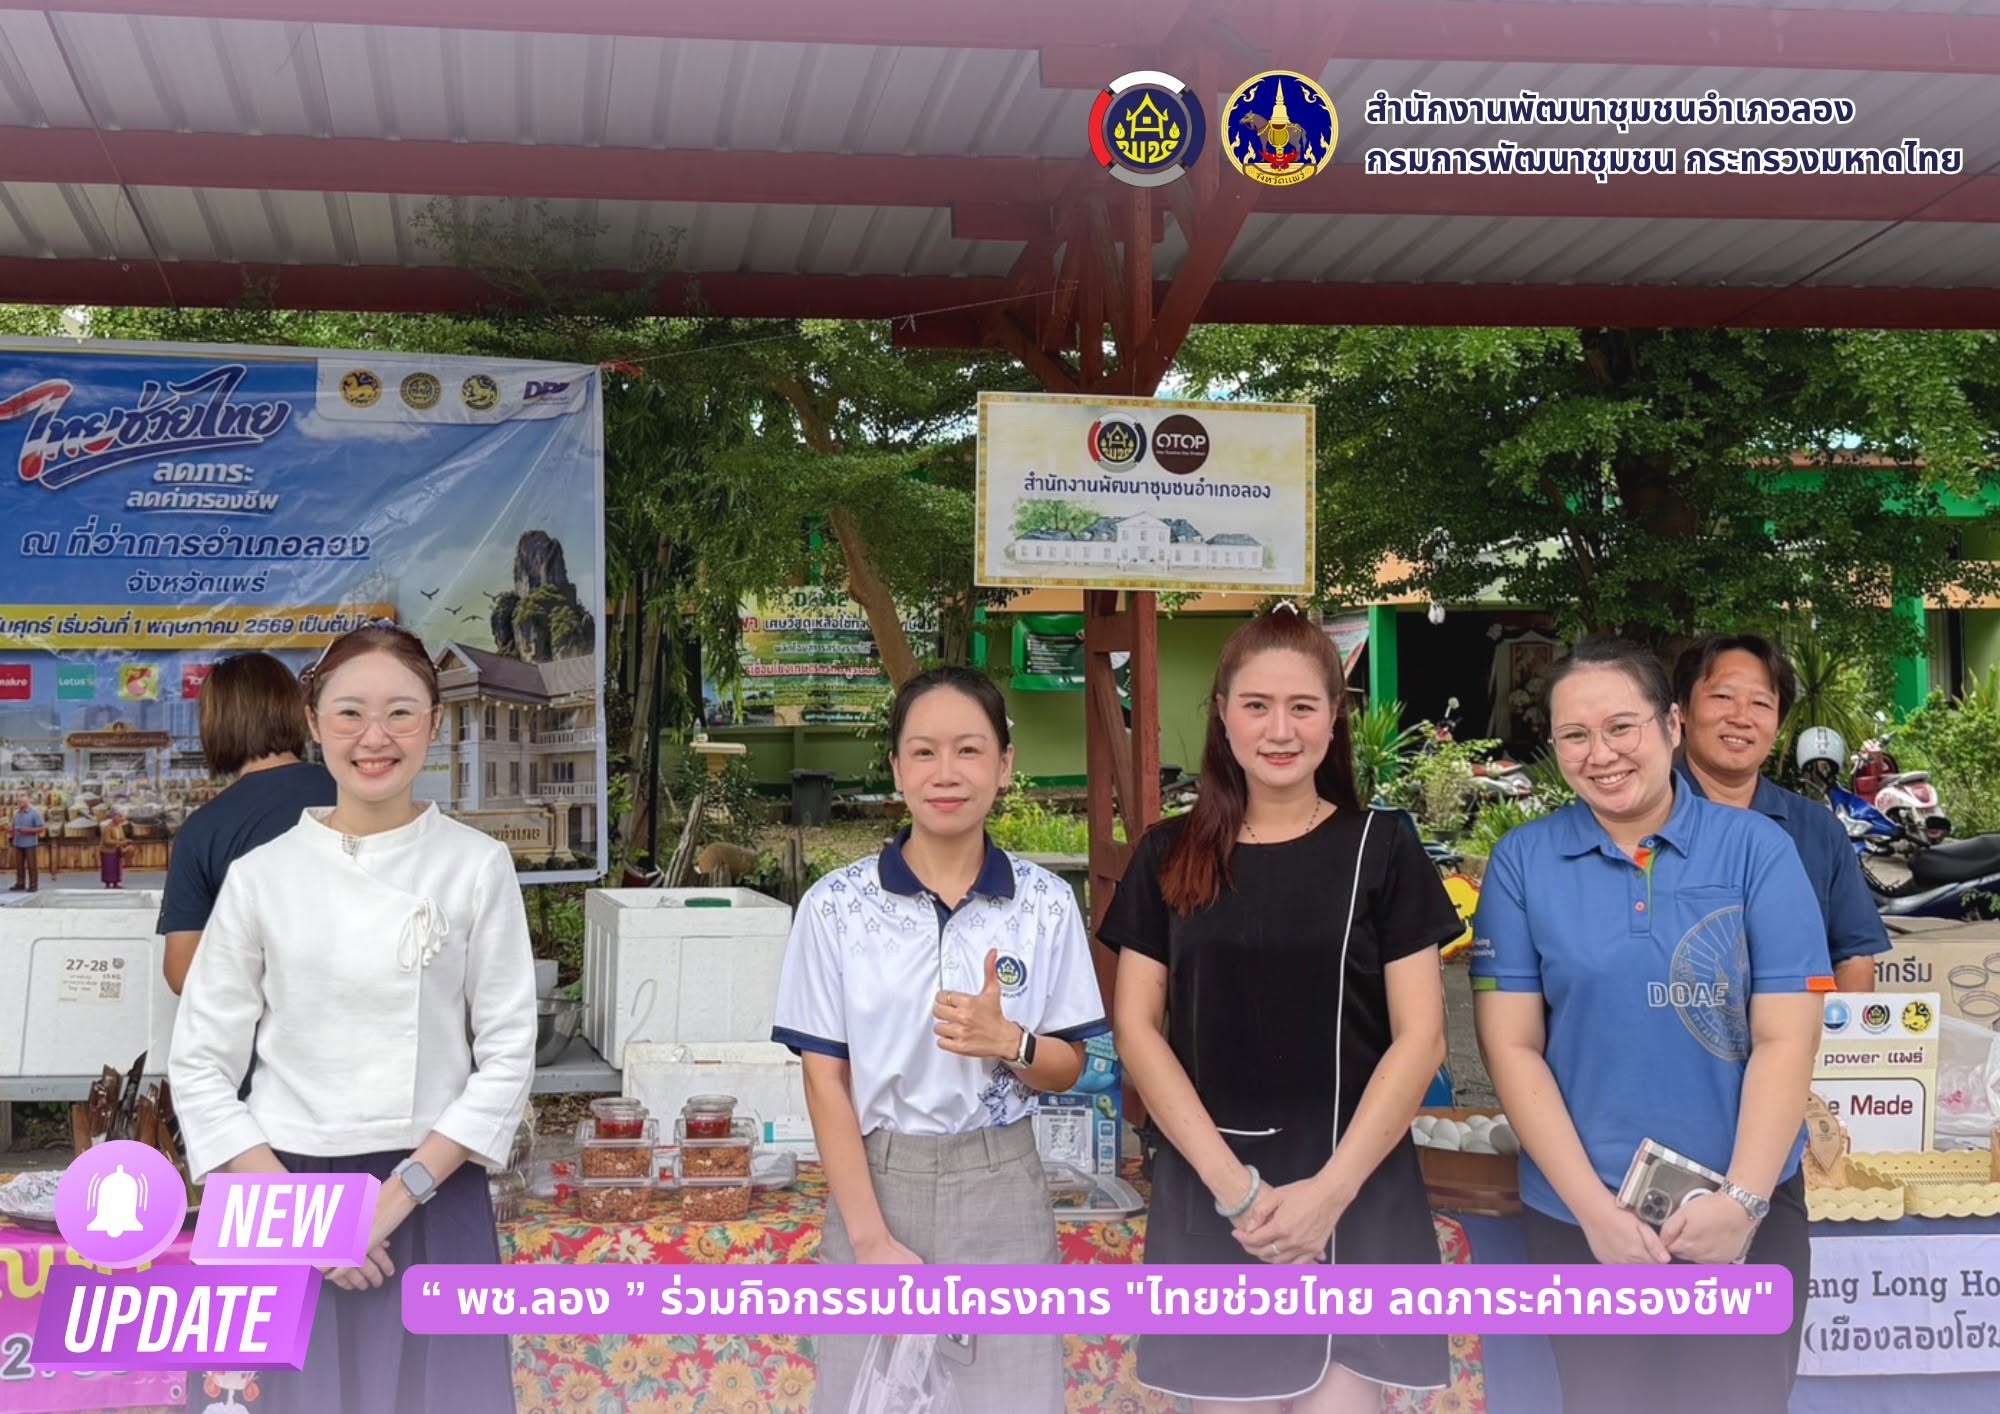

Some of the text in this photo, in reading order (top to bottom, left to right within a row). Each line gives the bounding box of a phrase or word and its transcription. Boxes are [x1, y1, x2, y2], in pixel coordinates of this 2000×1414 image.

[1156, 433, 1207, 448] OTOP
[153, 462, 254, 483] ลดภาระ
[1024, 471, 1271, 501] สำนักงานพัฒนาชุมชนอำเภอลอง
[126, 487, 279, 511] ลดค่าครองชีพ
[22, 517, 370, 558] ณ ที่ว่าการอำเภอลอง
[127, 570, 267, 594] จังหวัดแพร่
[57, 611, 131, 634] เริ่มวันที่
[133, 619, 141, 634] 1
[147, 618, 239, 636] พฤษภาคม
[244, 618, 294, 633] 2569
[65, 958, 109, 972] 27-28
[1647, 981, 1729, 1008] DOAE
[1824, 1046, 1923, 1067] power แพร่
[1850, 1095, 1913, 1116] Made
[1872, 1271, 1948, 1303] Long
